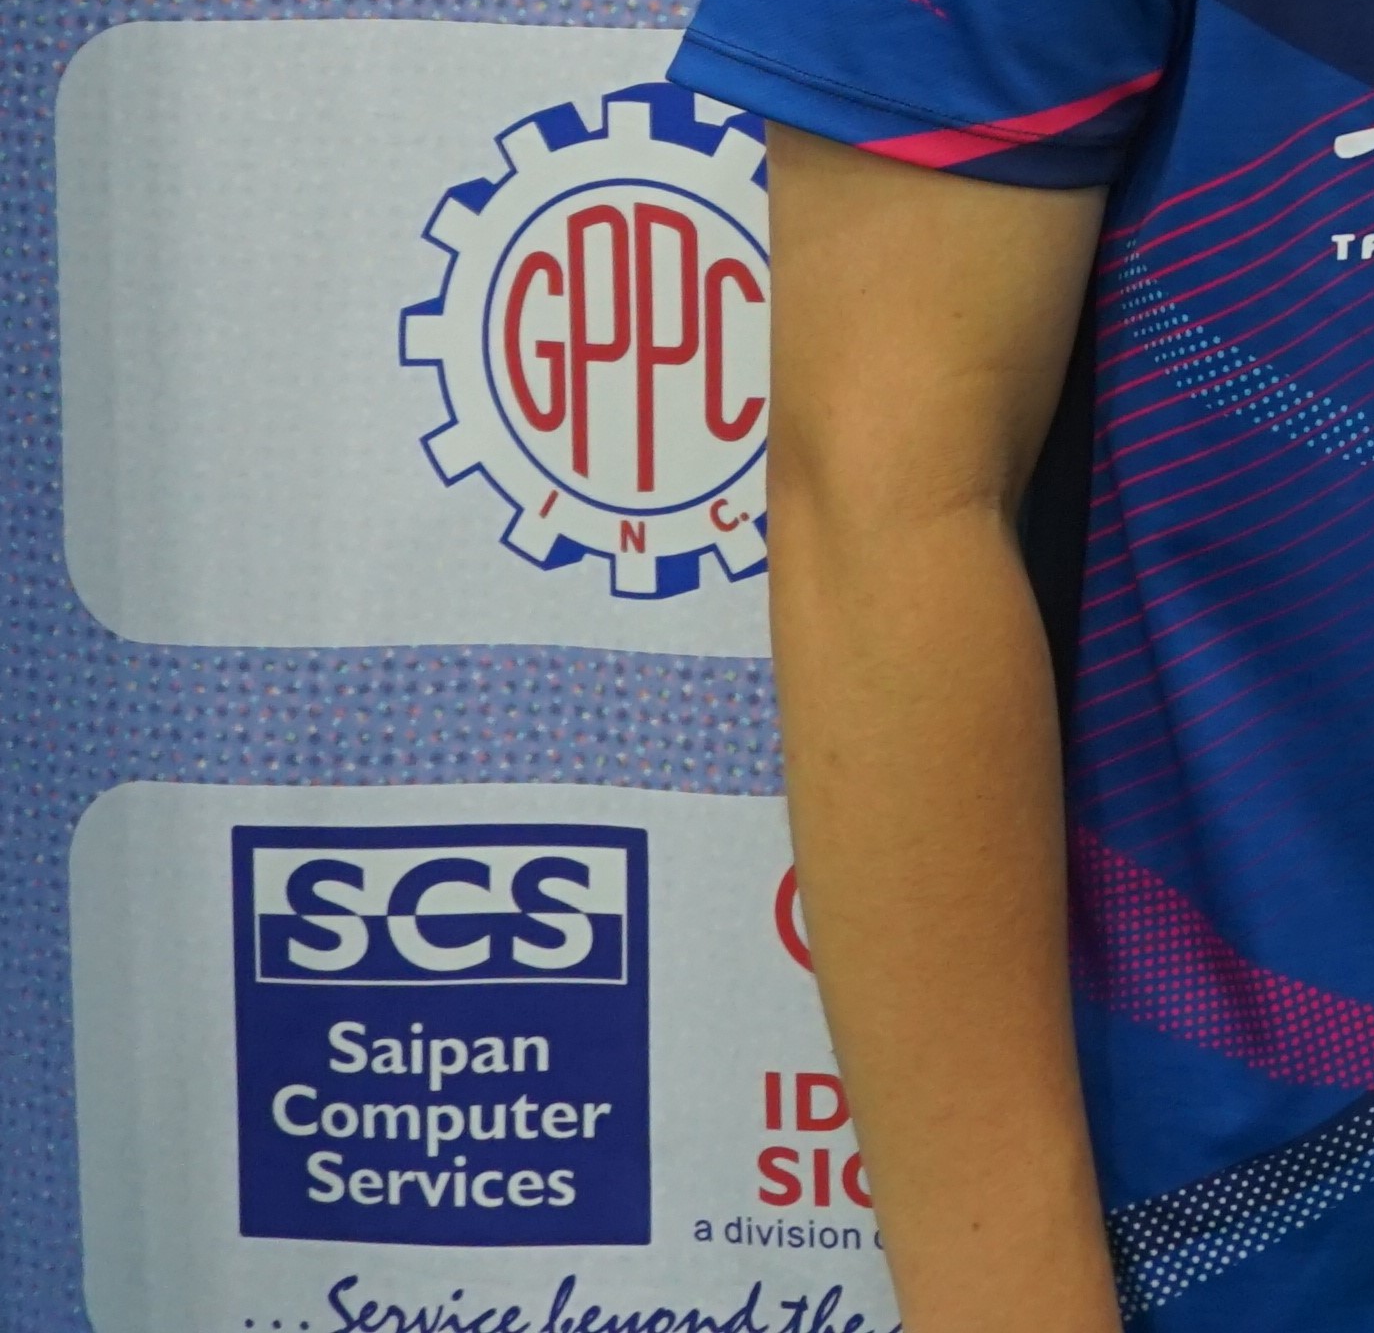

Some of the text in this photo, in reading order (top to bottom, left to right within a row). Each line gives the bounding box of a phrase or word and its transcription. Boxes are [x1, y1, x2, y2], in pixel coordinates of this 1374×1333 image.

[503, 202, 766, 493] GPPC
[284, 856, 594, 973] SCS
[328, 1021, 550, 1092] Saipan
[271, 1084, 612, 1158] Computer
[305, 1152, 577, 1209] Services
[693, 1218, 713, 1243] a
[723, 1216, 862, 1251] division
